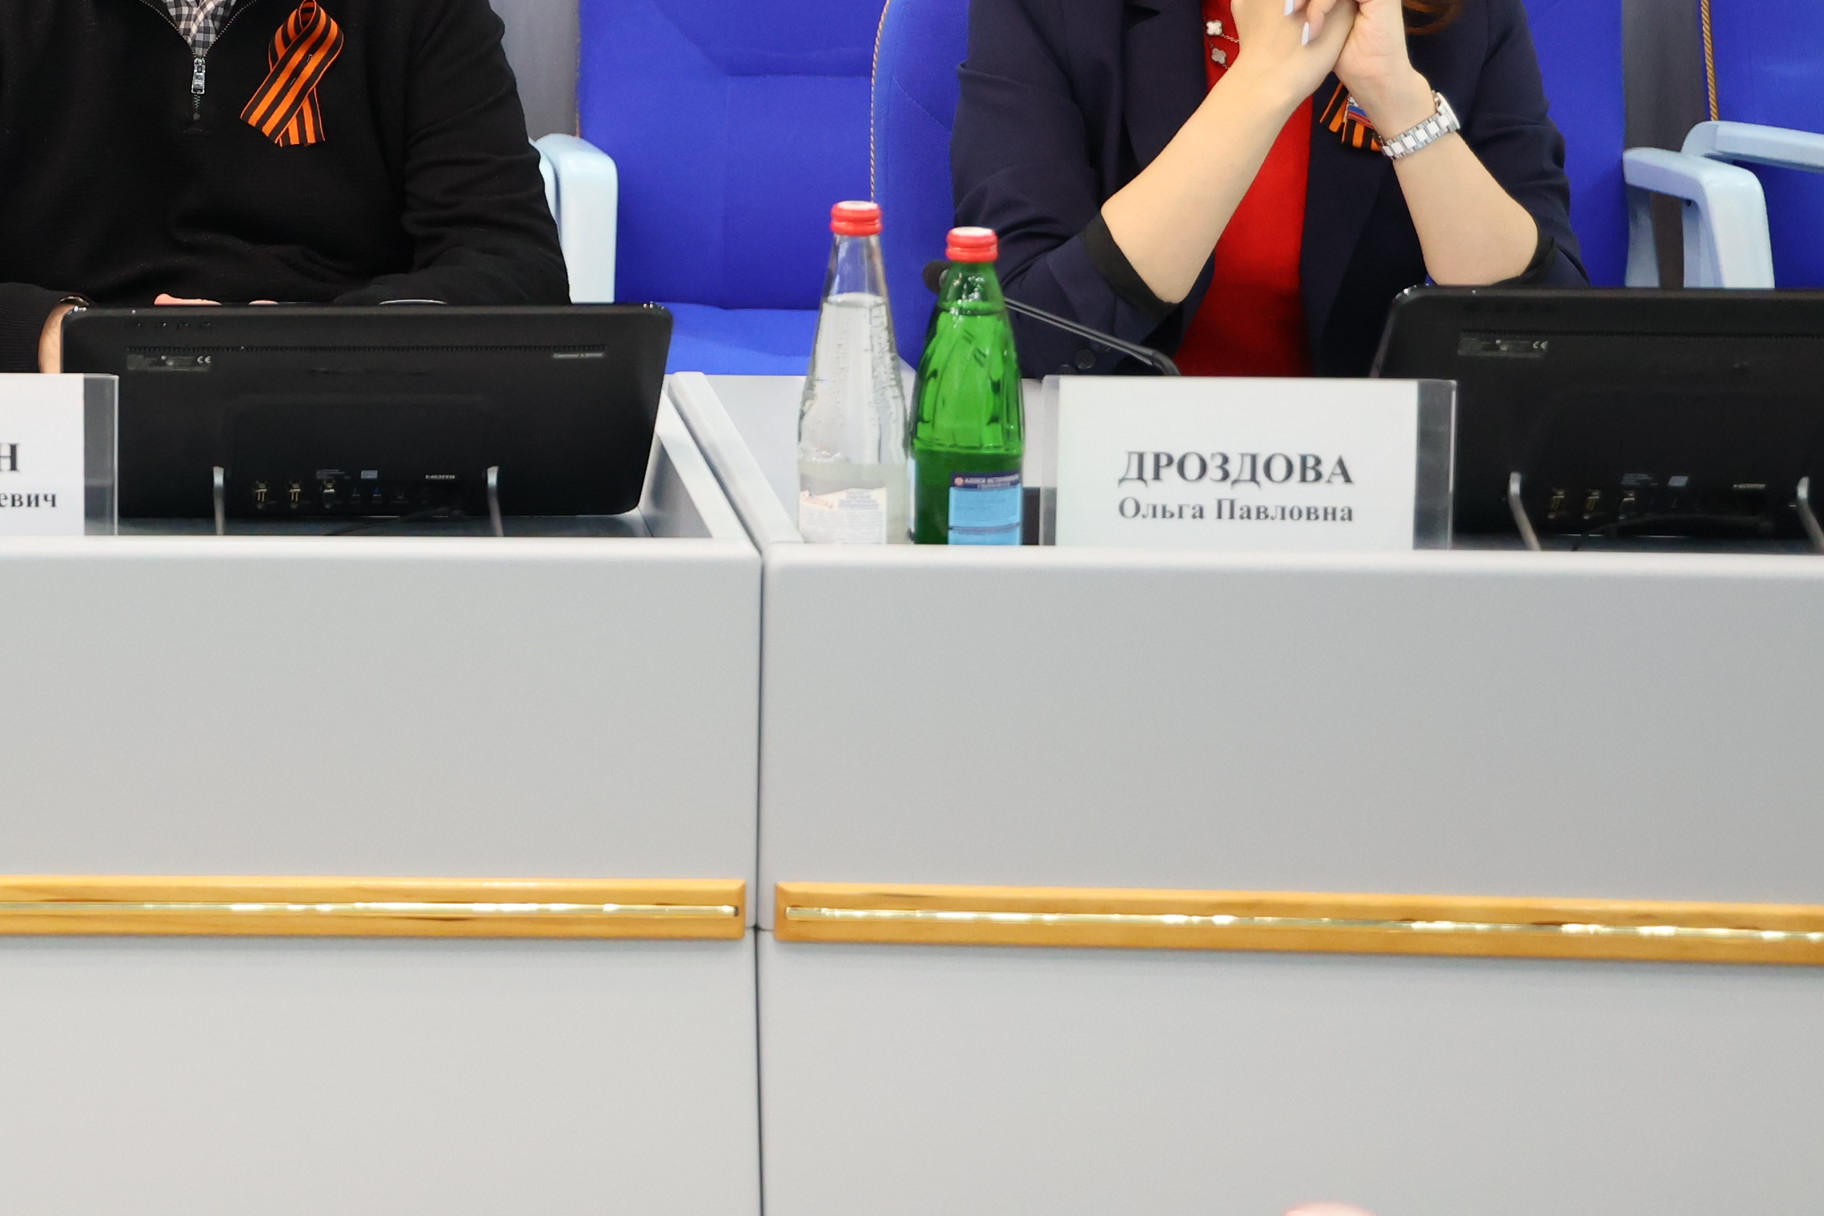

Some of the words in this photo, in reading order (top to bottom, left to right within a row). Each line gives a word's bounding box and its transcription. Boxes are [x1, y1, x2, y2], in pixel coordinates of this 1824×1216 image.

[1117, 450, 1354, 490] ДРОЗДОВА
[1117, 496, 1205, 520] Ольга
[1215, 497, 1354, 522] Павловна
